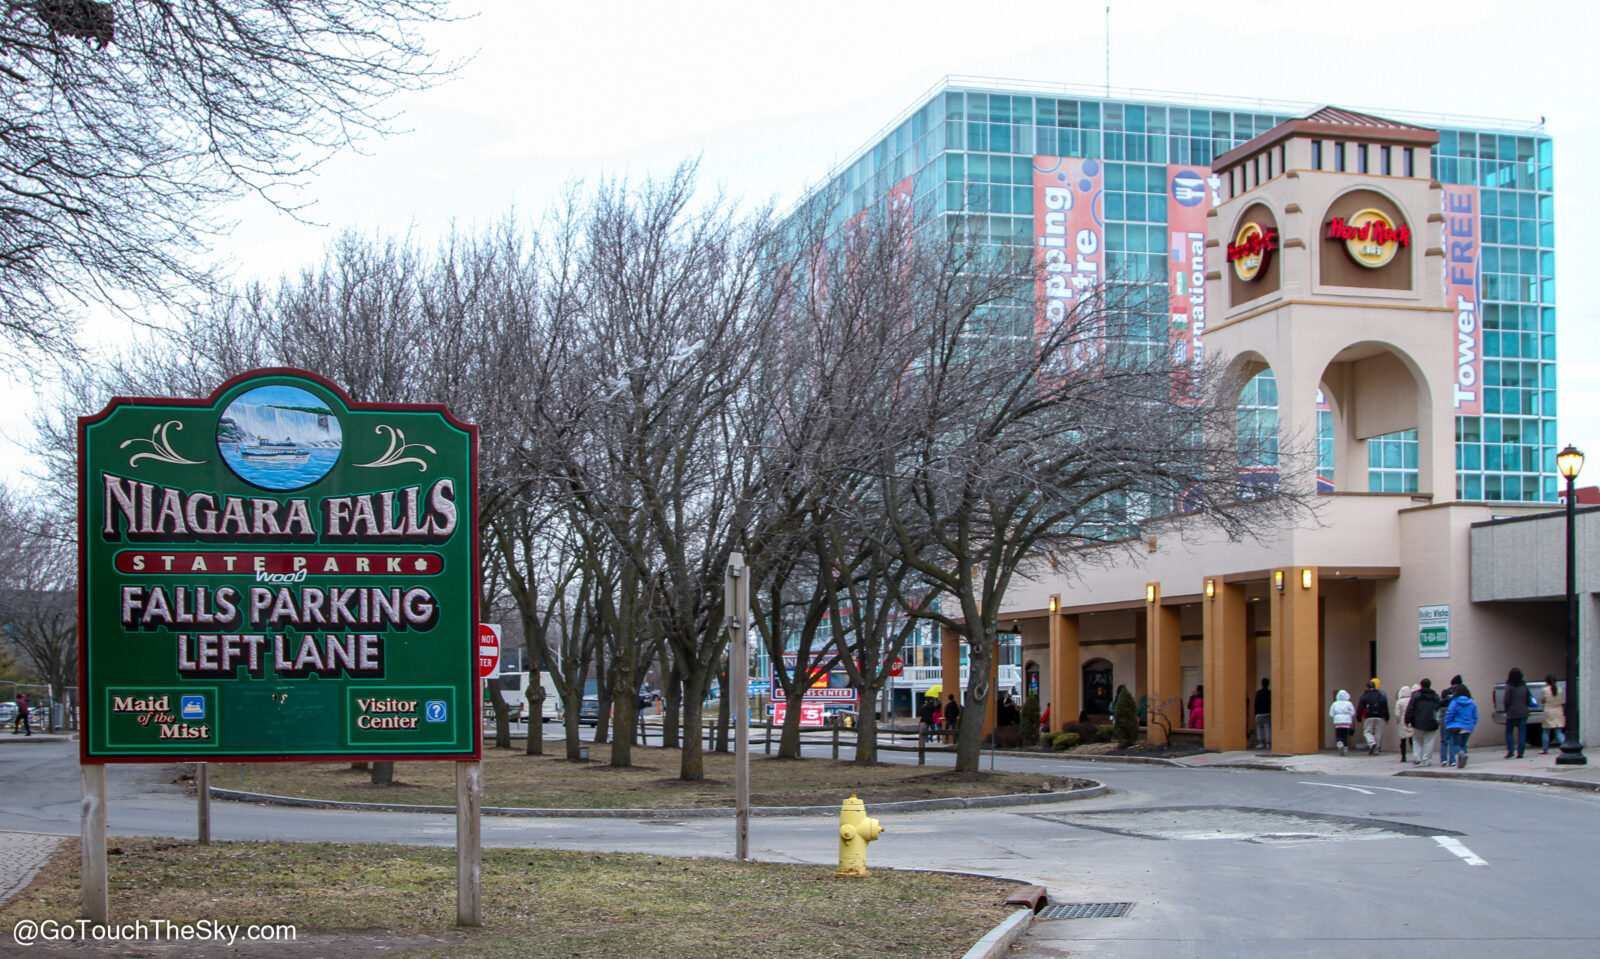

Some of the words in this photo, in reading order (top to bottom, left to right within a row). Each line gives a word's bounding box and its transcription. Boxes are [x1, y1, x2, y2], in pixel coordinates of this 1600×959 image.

[1331, 217, 1370, 241] Hard
[1372, 220, 1411, 247] Rock
[1449, 192, 1475, 287] FREE
[1038, 185, 1074, 373] opping
[1454, 294, 1478, 410] Tower
[102, 473, 316, 536] NIAGARA
[327, 478, 458, 537] FALLS
[133, 556, 266, 571] STATE
[293, 556, 402, 572] PARK
[122, 586, 237, 624] FALLS
[250, 586, 434, 625] PARKING
[481, 635, 494, 643] NOT
[177, 634, 265, 671] LEFT
[273, 634, 379, 671] LANE
[480, 658, 492, 667] TER
[817, 688, 848, 697] CENTER
[113, 696, 170, 712] Maid
[357, 698, 418, 713] Visitor
[137, 712, 153, 725] of
[154, 712, 175, 724] the
[357, 715, 418, 729] Center
[160, 723, 209, 739] Mist
